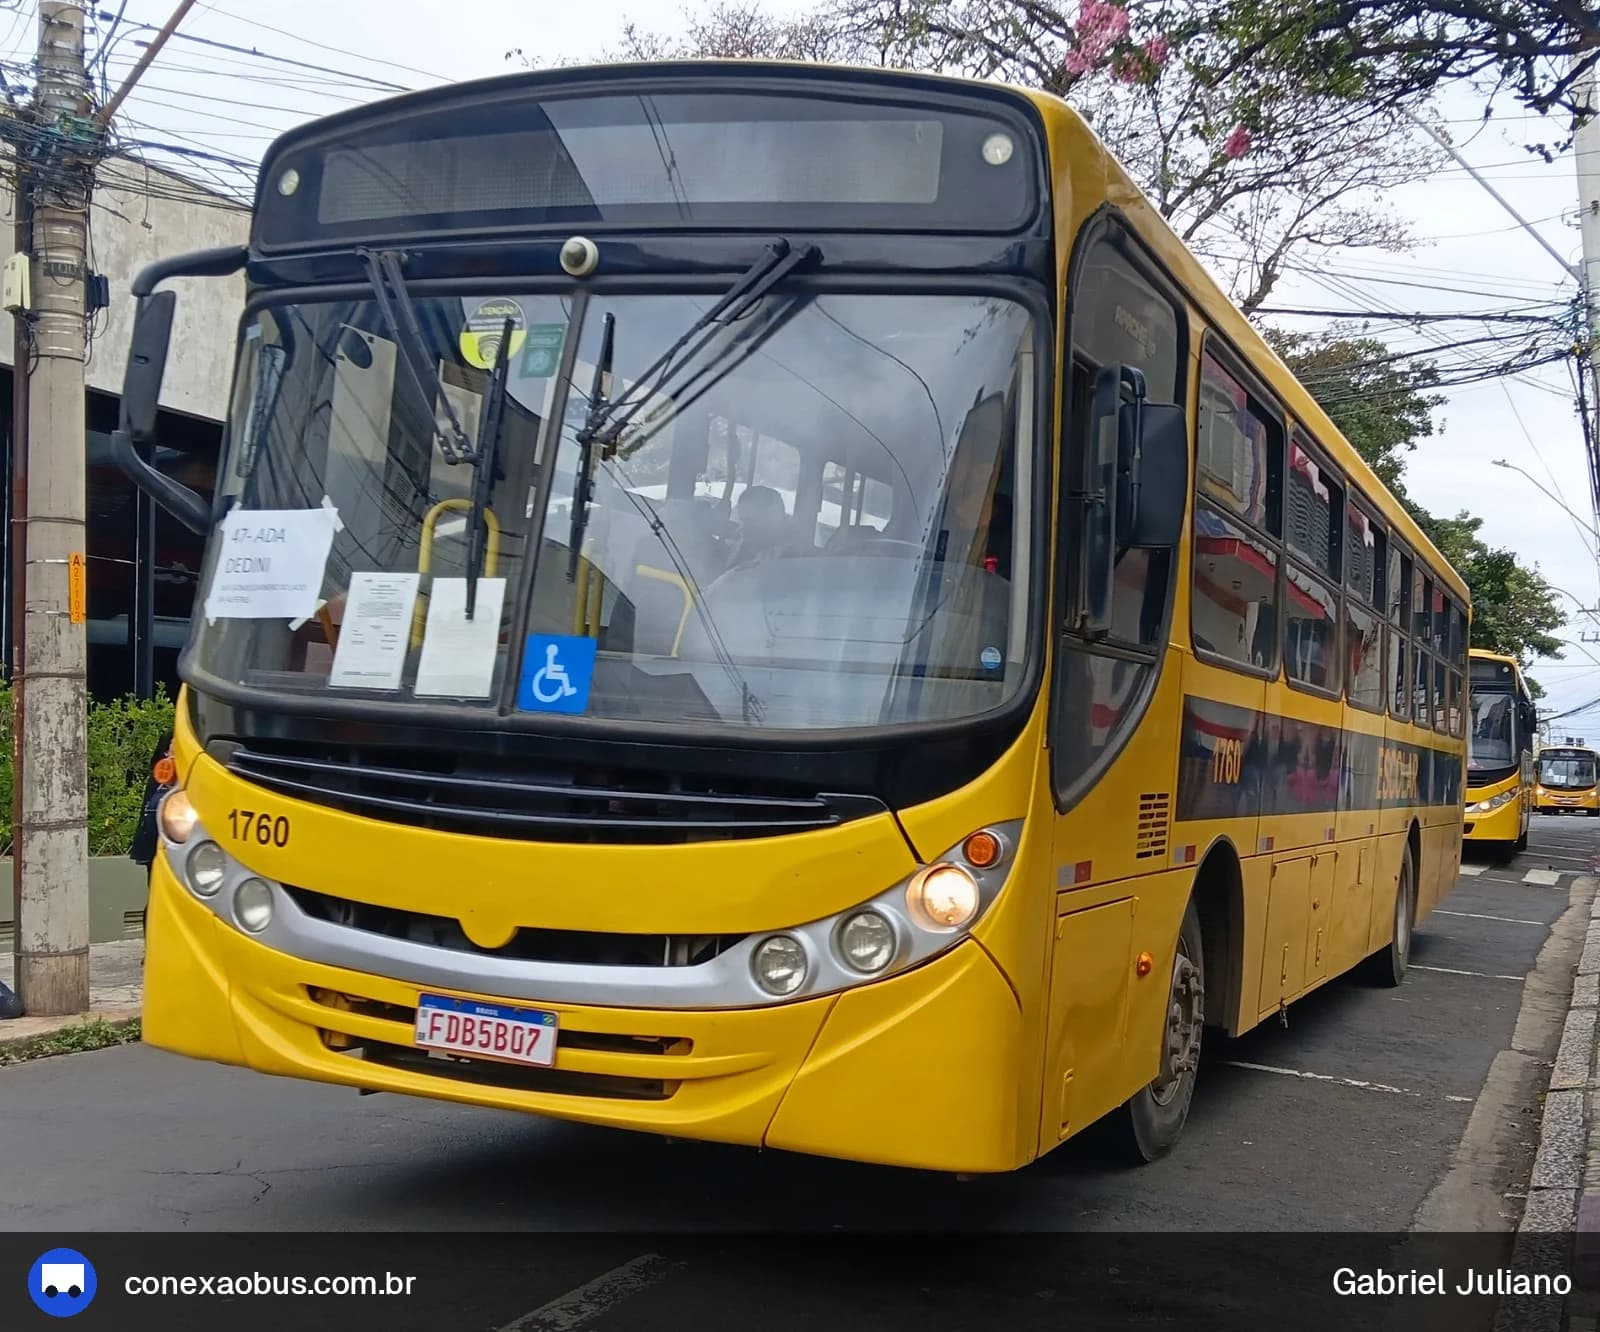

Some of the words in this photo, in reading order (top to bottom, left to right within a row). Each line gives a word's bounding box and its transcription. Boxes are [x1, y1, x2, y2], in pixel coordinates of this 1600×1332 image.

[255, 528, 286, 544] ADA
[225, 557, 273, 575] DEDINI
[1213, 737, 1242, 784] 1760
[1376, 747, 1419, 800] ESCOLAR
[228, 808, 290, 848] 1760
[429, 1012, 541, 1057] FDB5B07
